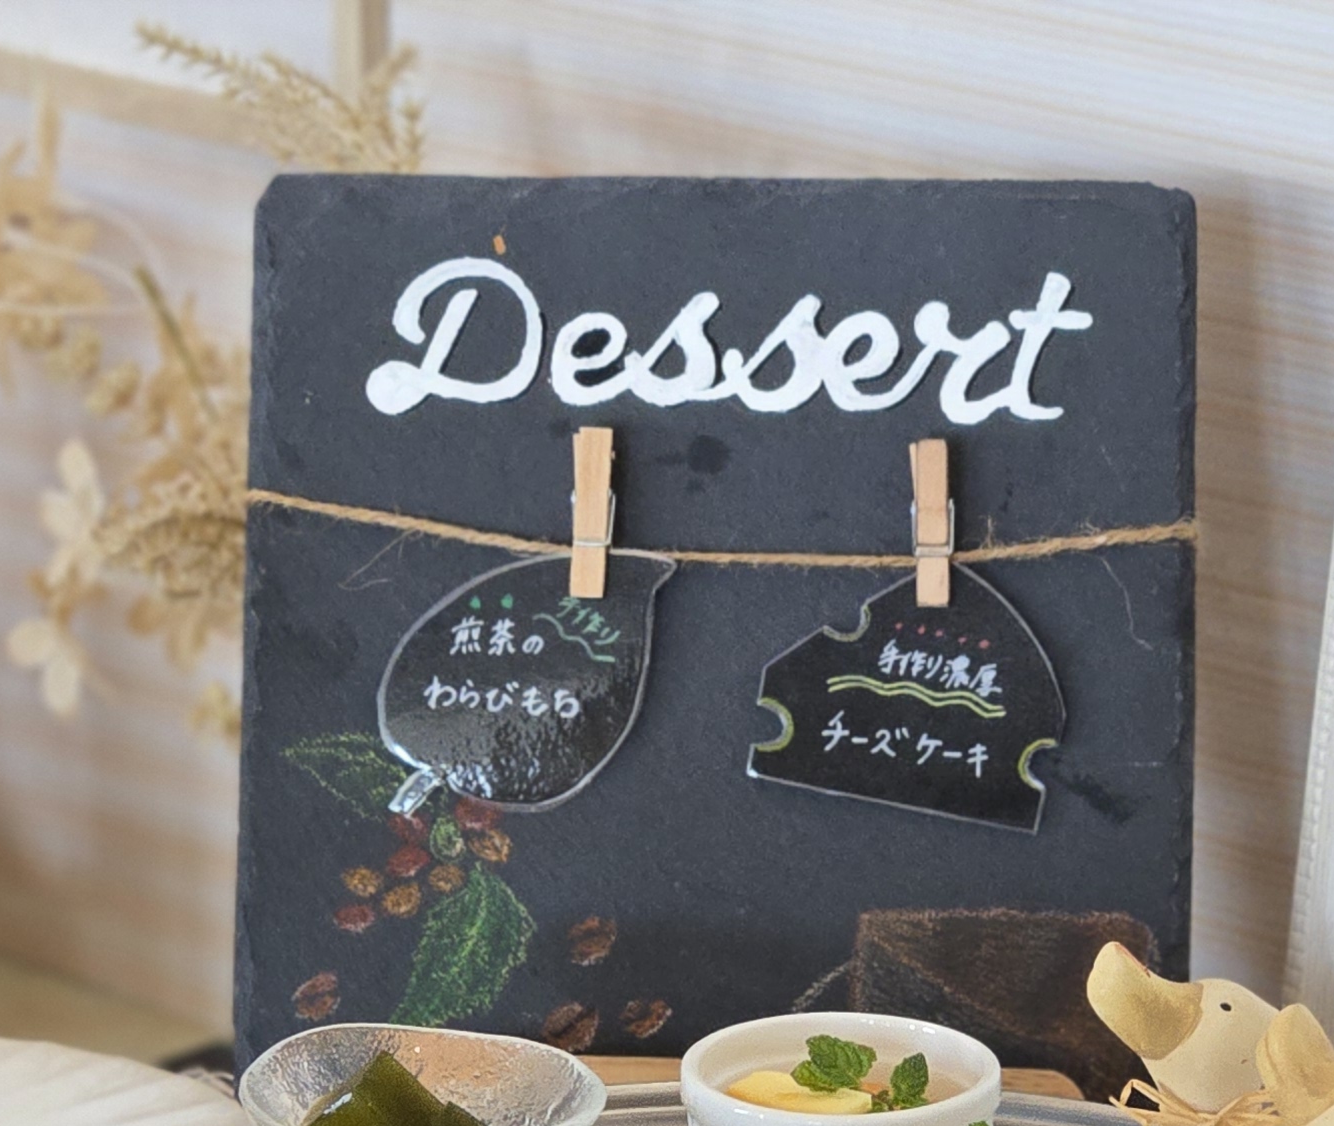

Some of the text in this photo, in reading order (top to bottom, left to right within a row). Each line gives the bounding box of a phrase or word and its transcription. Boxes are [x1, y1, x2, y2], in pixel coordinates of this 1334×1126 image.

[365, 256, 1094, 425] Dessert
[449, 615, 545, 656] 煎茶の
[423, 675, 581, 719] わらびもち
[878, 639, 1003, 697] 手作り濃厚
[821, 710, 989, 778] チーズケーキ
